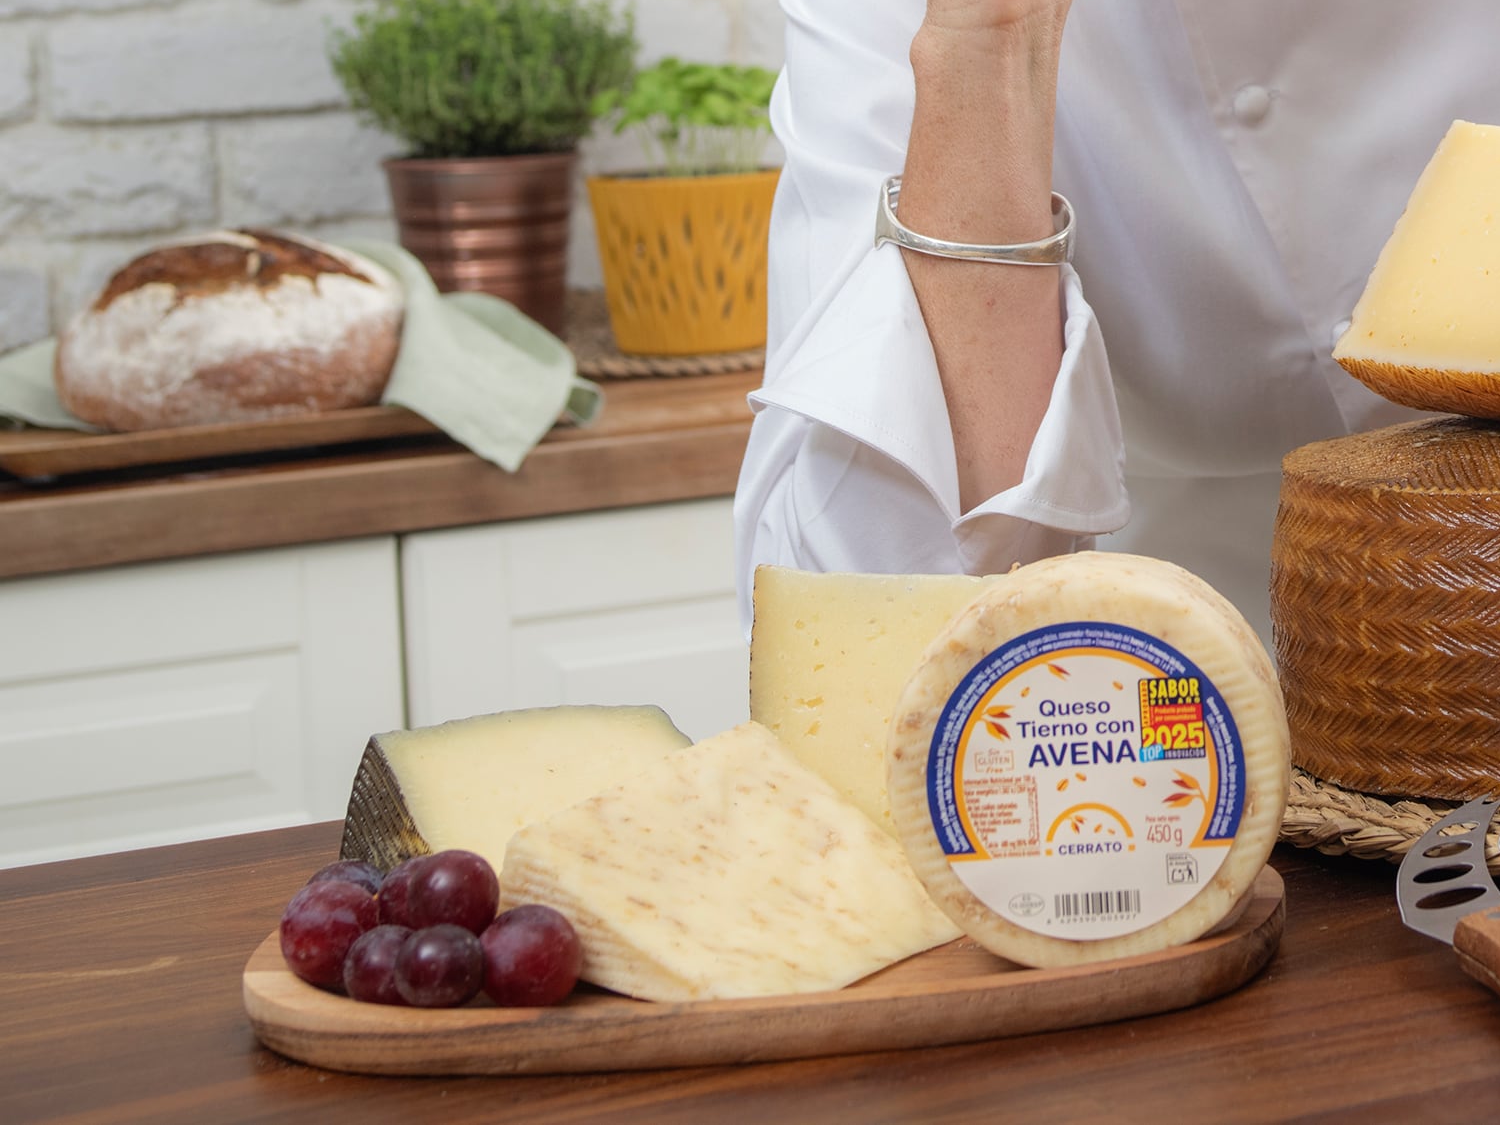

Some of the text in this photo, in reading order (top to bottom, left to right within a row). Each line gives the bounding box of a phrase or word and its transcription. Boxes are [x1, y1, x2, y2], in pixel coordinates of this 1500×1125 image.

[1149, 677, 1200, 698] SABOR
[1039, 699, 1111, 718] Queso
[1016, 719, 1135, 740] Tierno con
[1142, 721, 1205, 751] 2025
[1028, 739, 1137, 768] AVENA
[1141, 744, 1163, 761] TOP
[1146, 824, 1183, 847] 450 g
[1058, 841, 1123, 857] CERRATO
